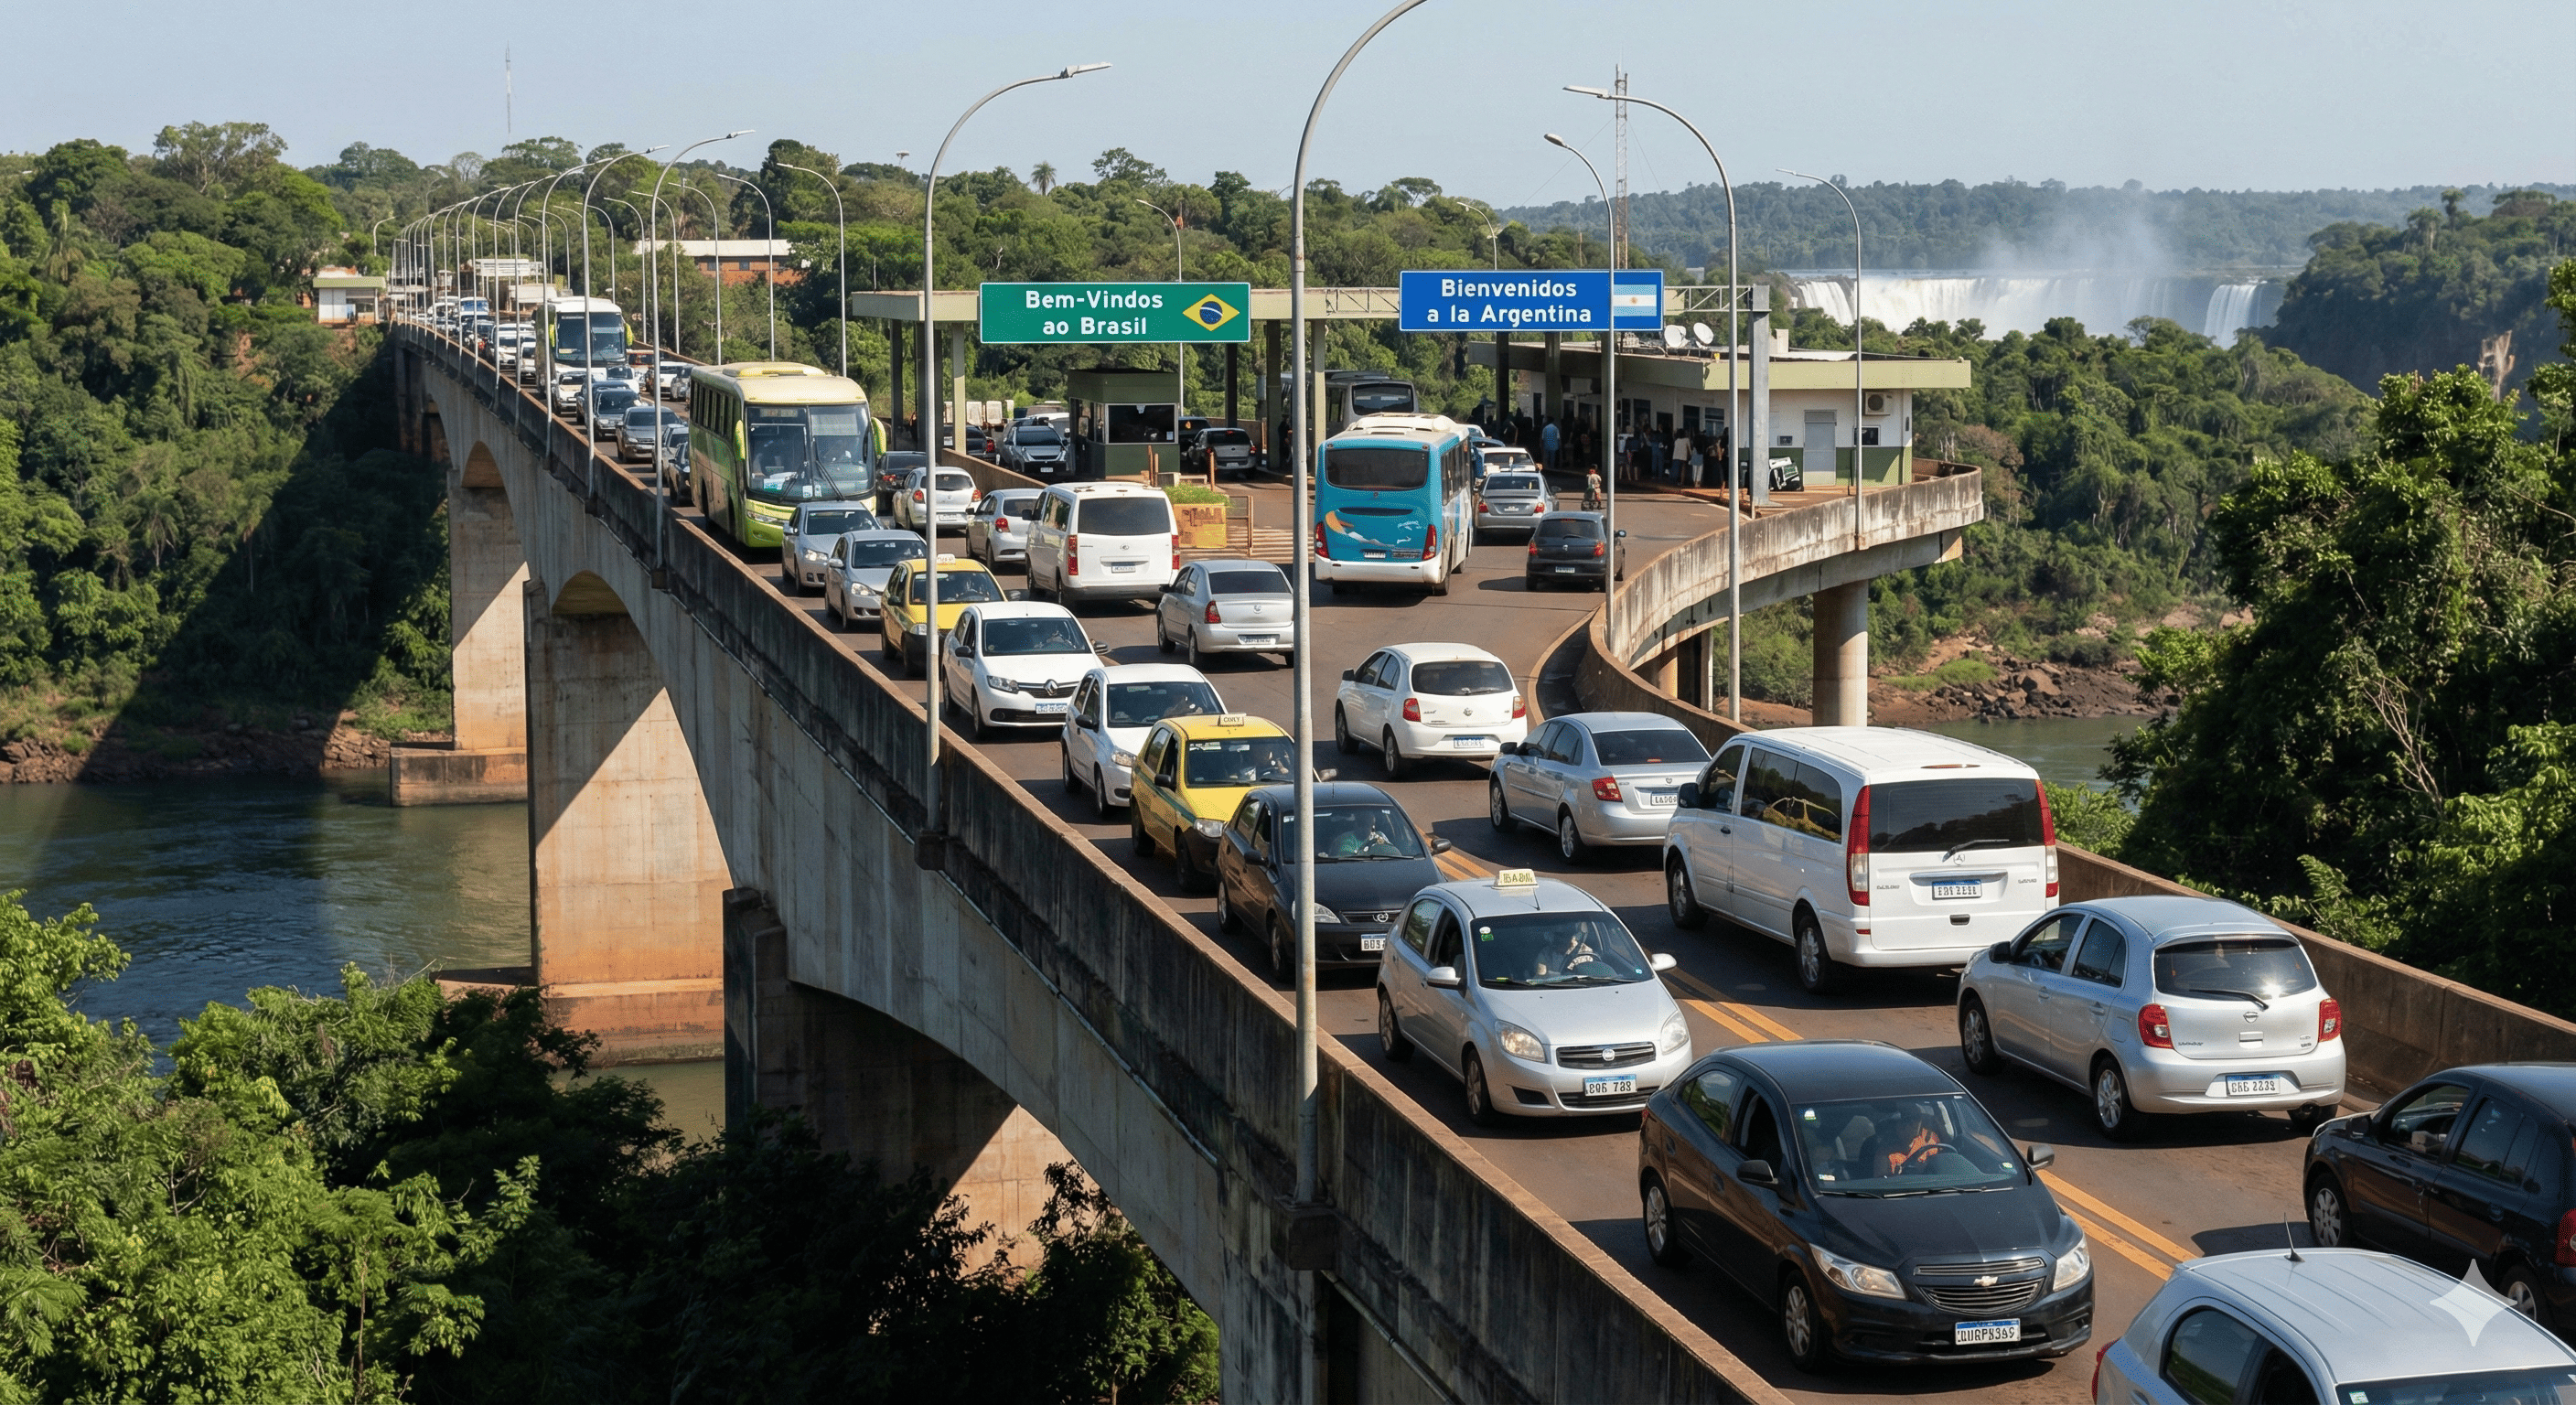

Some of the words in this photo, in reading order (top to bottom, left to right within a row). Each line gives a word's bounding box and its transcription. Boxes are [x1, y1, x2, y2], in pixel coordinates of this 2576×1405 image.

[1441, 278, 1577, 297] Bienvenidos
[1025, 290, 1164, 308] Bem-Vindos
[1426, 308, 1439, 322] a
[1450, 305, 1470, 322] la
[1480, 304, 1592, 327] Argentina
[1042, 320, 1069, 335] ao
[1080, 316, 1147, 335] Brasil
